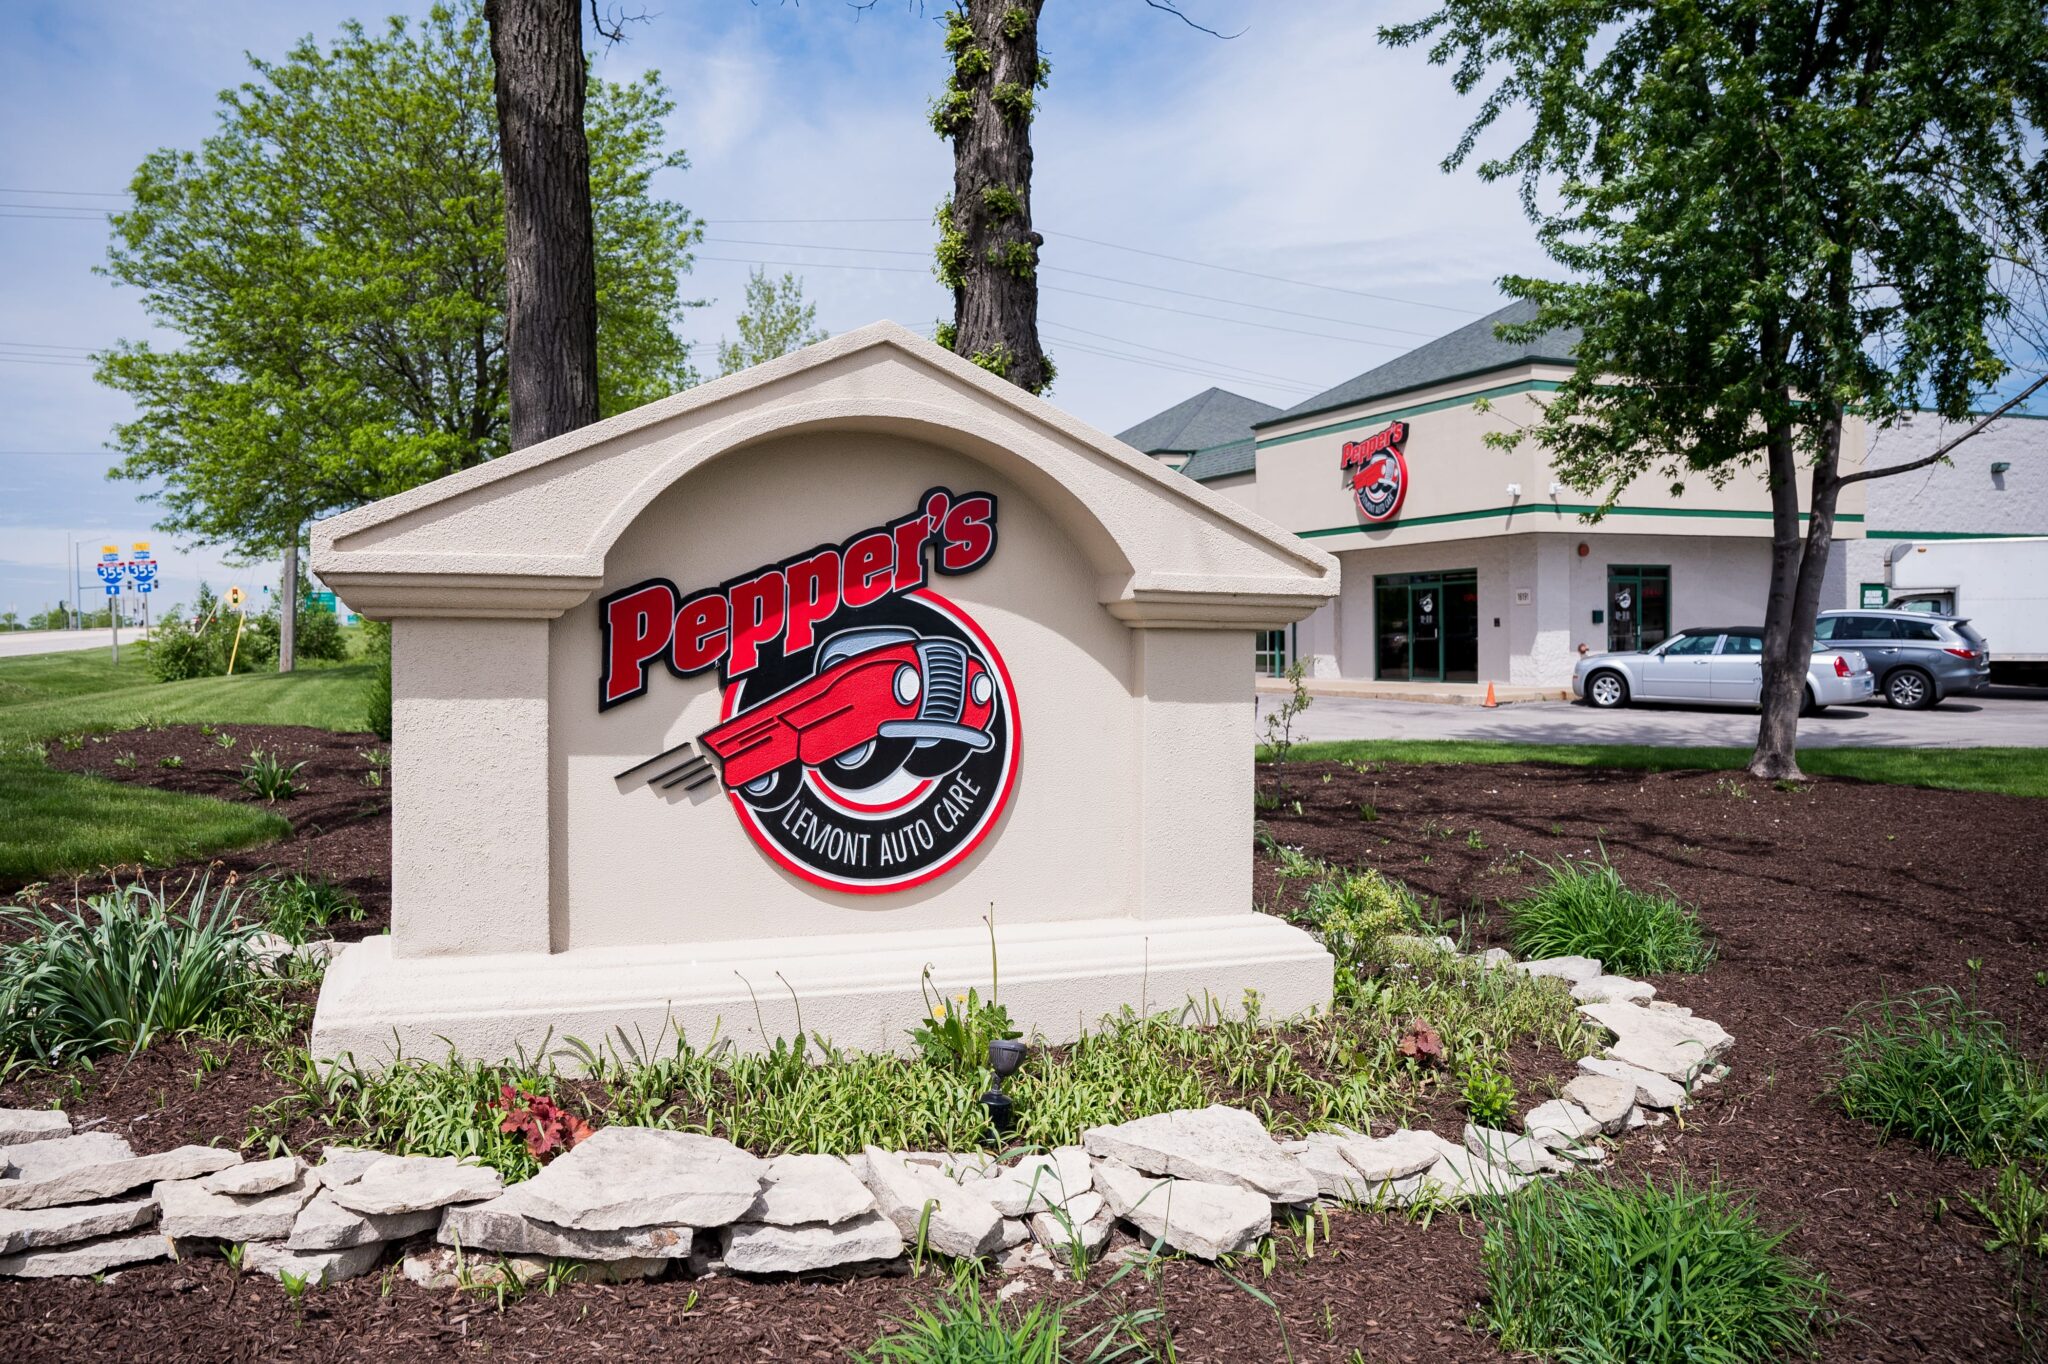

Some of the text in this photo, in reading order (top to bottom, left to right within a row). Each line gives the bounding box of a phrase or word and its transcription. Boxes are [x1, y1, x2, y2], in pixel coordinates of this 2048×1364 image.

[1341, 421, 1403, 468] Pepper's
[98, 566, 125, 579] 355
[130, 564, 156, 577] 355
[606, 493, 993, 702] Pepper's
[782, 771, 981, 867] LEMONT AUTO CARE
